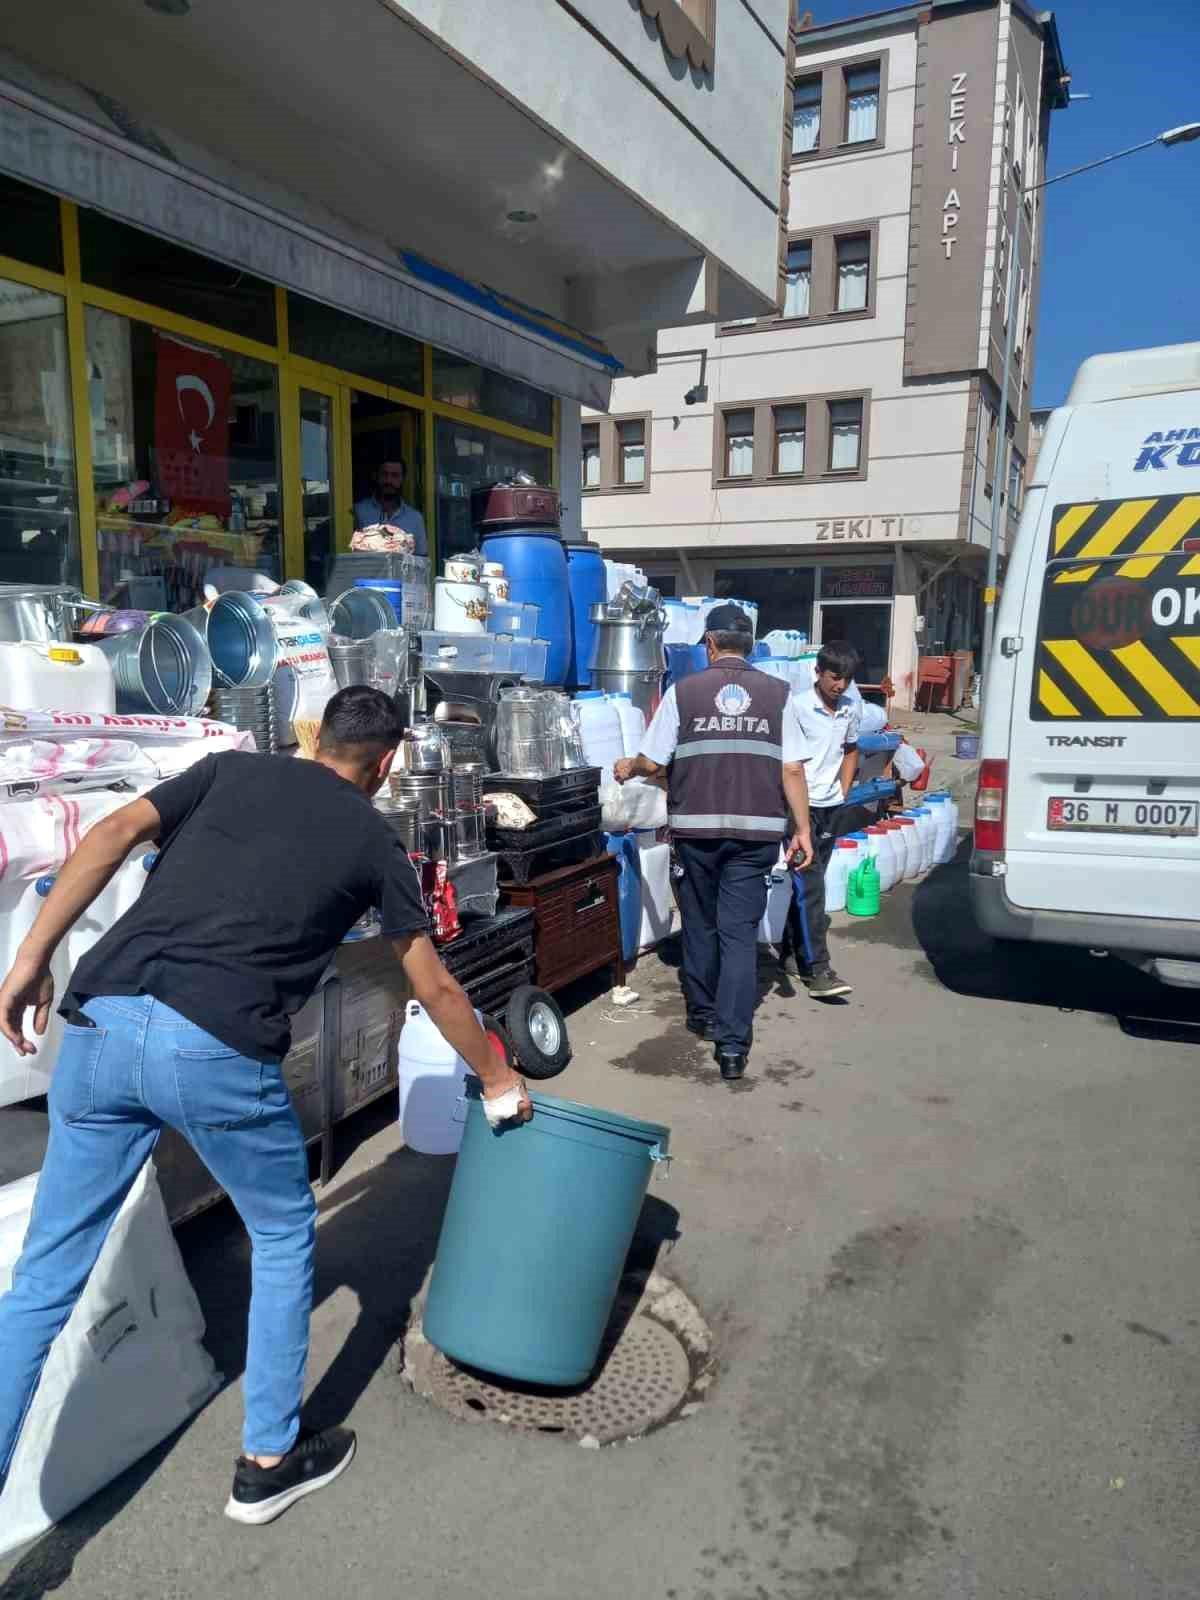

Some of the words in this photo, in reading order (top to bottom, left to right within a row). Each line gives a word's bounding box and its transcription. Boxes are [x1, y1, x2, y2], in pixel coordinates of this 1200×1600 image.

[941, 188, 961, 260] APT
[1046, 735, 1127, 748] TRANSIT
[1063, 802, 1089, 822] 36
[1105, 803, 1119, 823] M
[1135, 804, 1193, 826] 0007
